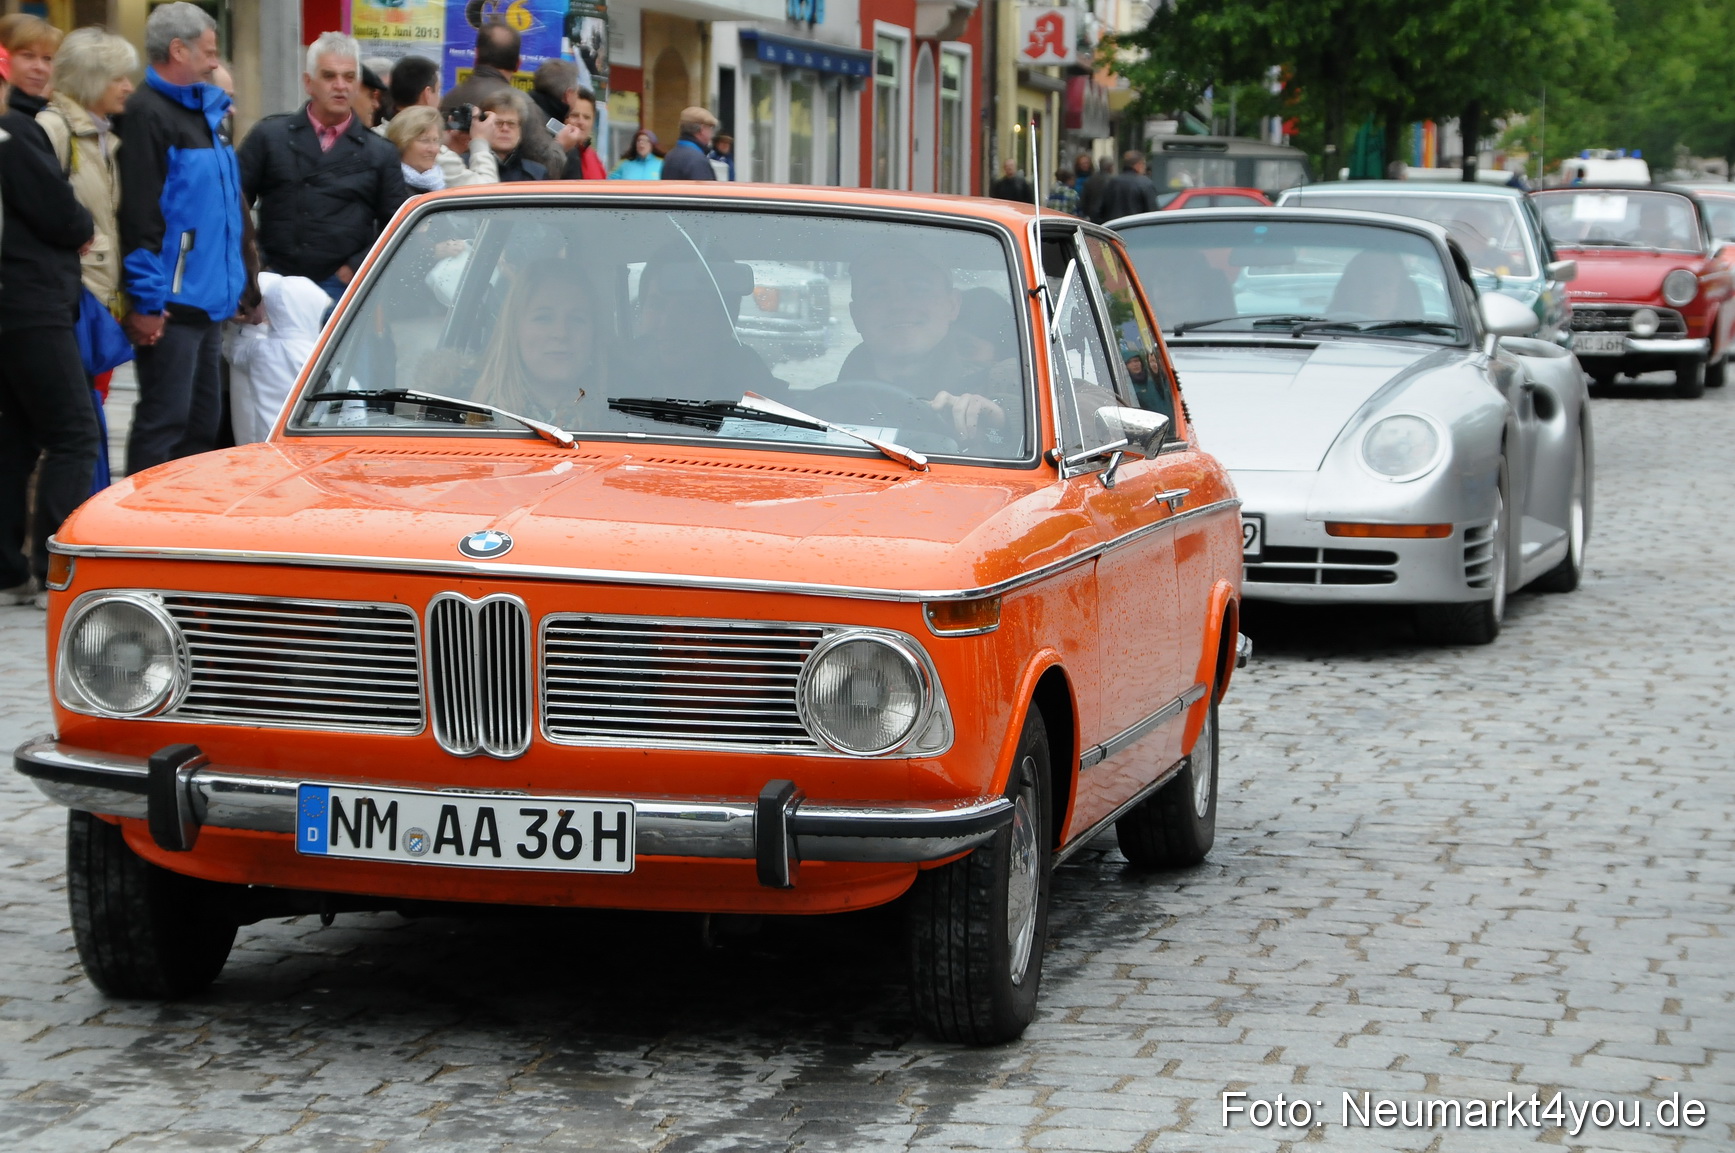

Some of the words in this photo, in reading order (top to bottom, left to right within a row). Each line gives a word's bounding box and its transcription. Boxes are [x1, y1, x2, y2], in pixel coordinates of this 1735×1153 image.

[382, 25, 390, 37] 2.
[392, 26, 411, 37] Juni
[415, 27, 440, 39] 2013
[307, 826, 319, 842] D
[330, 795, 399, 850] NM
[433, 804, 502, 858] AA
[516, 808, 627, 863] 36H
